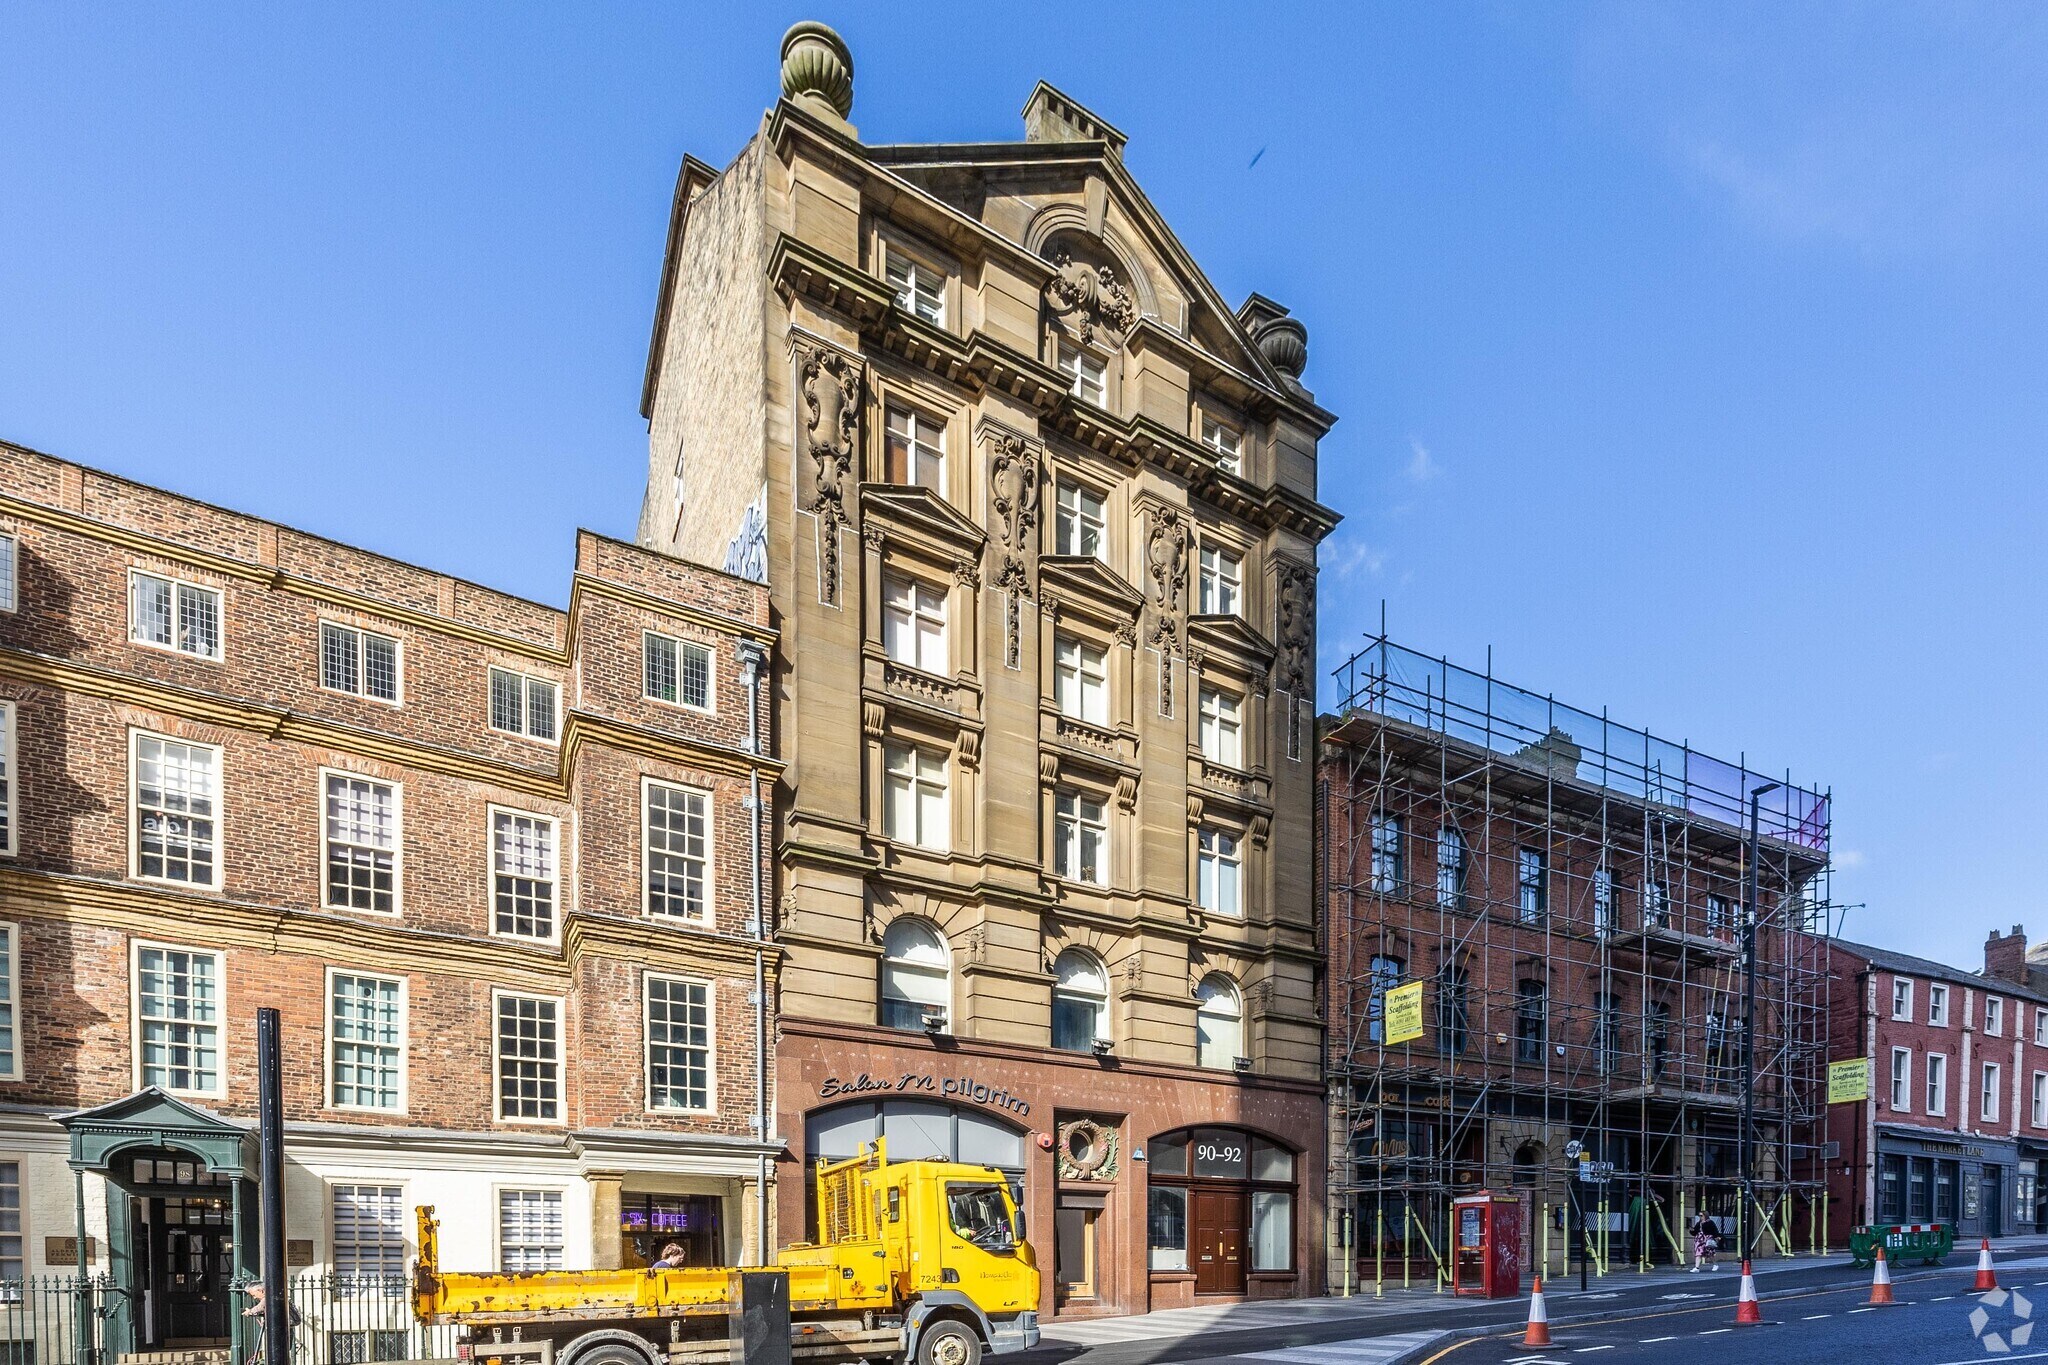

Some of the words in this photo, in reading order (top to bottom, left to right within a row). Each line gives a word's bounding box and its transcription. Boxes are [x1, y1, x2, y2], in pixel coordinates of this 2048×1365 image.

[1394, 991, 1415, 1003] Premier
[1388, 1001, 1419, 1014] Scaffolding
[1837, 1064, 1860, 1073] Premier
[1832, 1072, 1865, 1081] Scaffolding
[818, 1073, 892, 1098] Salon
[940, 1075, 1031, 1116] pilgrim
[1198, 1145, 1242, 1162] 90-92
[1923, 1142, 1937, 1152] THE
[1937, 1143, 1966, 1155] MARKET
[1967, 1146, 1984, 1157] LANE
[629, 1212, 644, 1225] SIX
[651, 1213, 687, 1227] COFFEE
[920, 1275, 941, 1283] 7243
